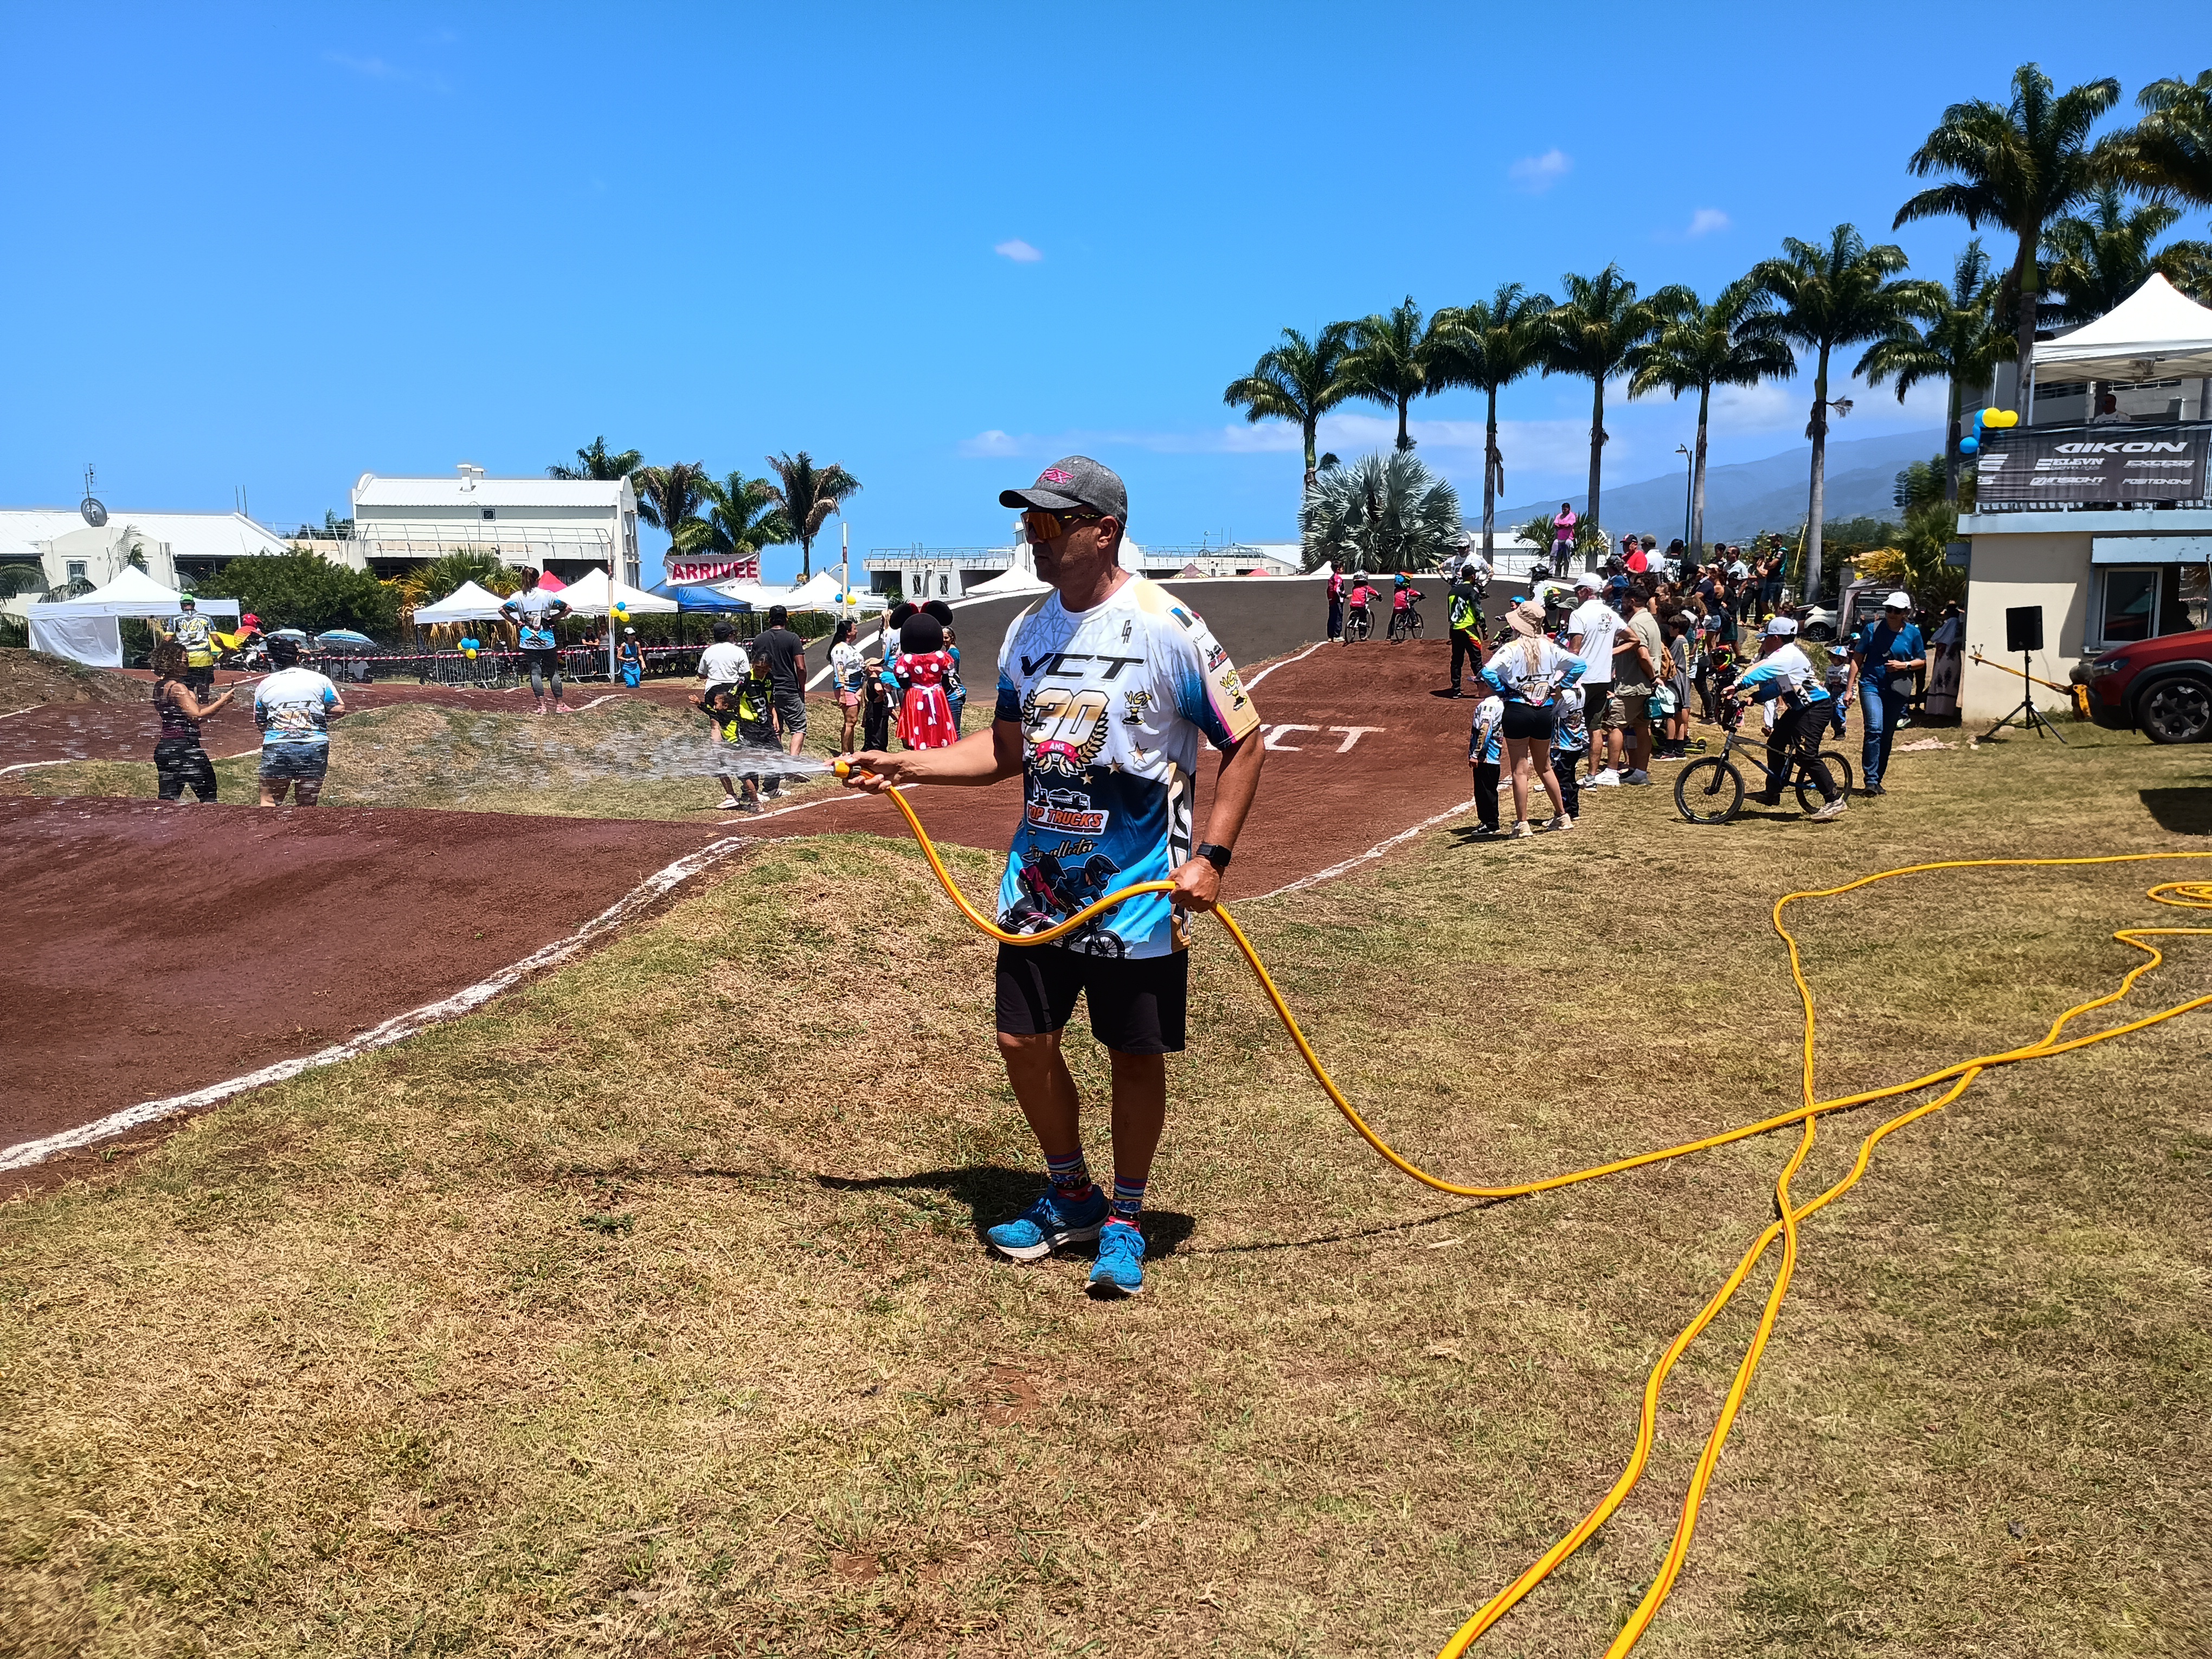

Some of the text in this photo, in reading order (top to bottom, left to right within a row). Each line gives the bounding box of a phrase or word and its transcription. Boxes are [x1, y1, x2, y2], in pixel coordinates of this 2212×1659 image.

[672, 561, 758, 580] ARRIVEE
[1020, 652, 1145, 680] VCT
[1024, 687, 1110, 747] 30
[1049, 743, 1065, 751] ANS
[1028, 805, 1045, 820] TOP
[1047, 809, 1104, 827] TRUCKS
